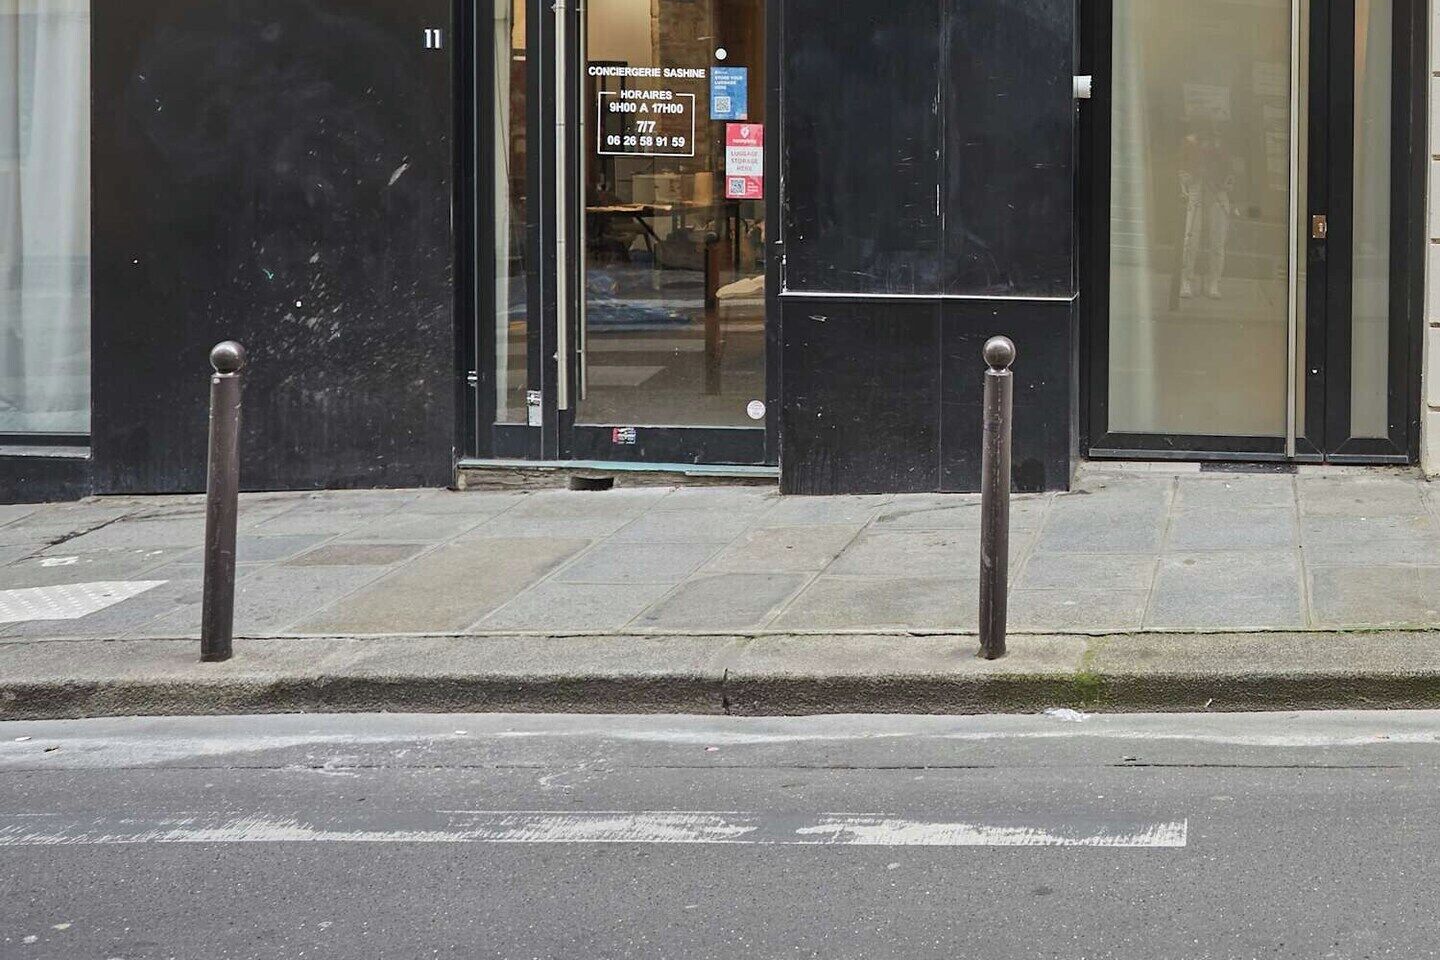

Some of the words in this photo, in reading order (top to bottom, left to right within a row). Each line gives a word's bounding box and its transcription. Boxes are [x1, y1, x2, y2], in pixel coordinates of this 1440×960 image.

[424, 28, 441, 49] 11
[588, 66, 661, 77] CONCIERGERIE
[663, 68, 706, 78] SASHINE
[620, 90, 673, 100] HORAIRES
[609, 102, 637, 113] 9H00
[639, 103, 649, 113] A
[652, 103, 684, 114] 17H00
[636, 120, 656, 133] 7/7
[607, 135, 621, 146] 06
[623, 135, 637, 146] 26
[639, 136, 653, 146] 58
[656, 136, 668, 147] 91
[671, 137, 686, 147] 59
